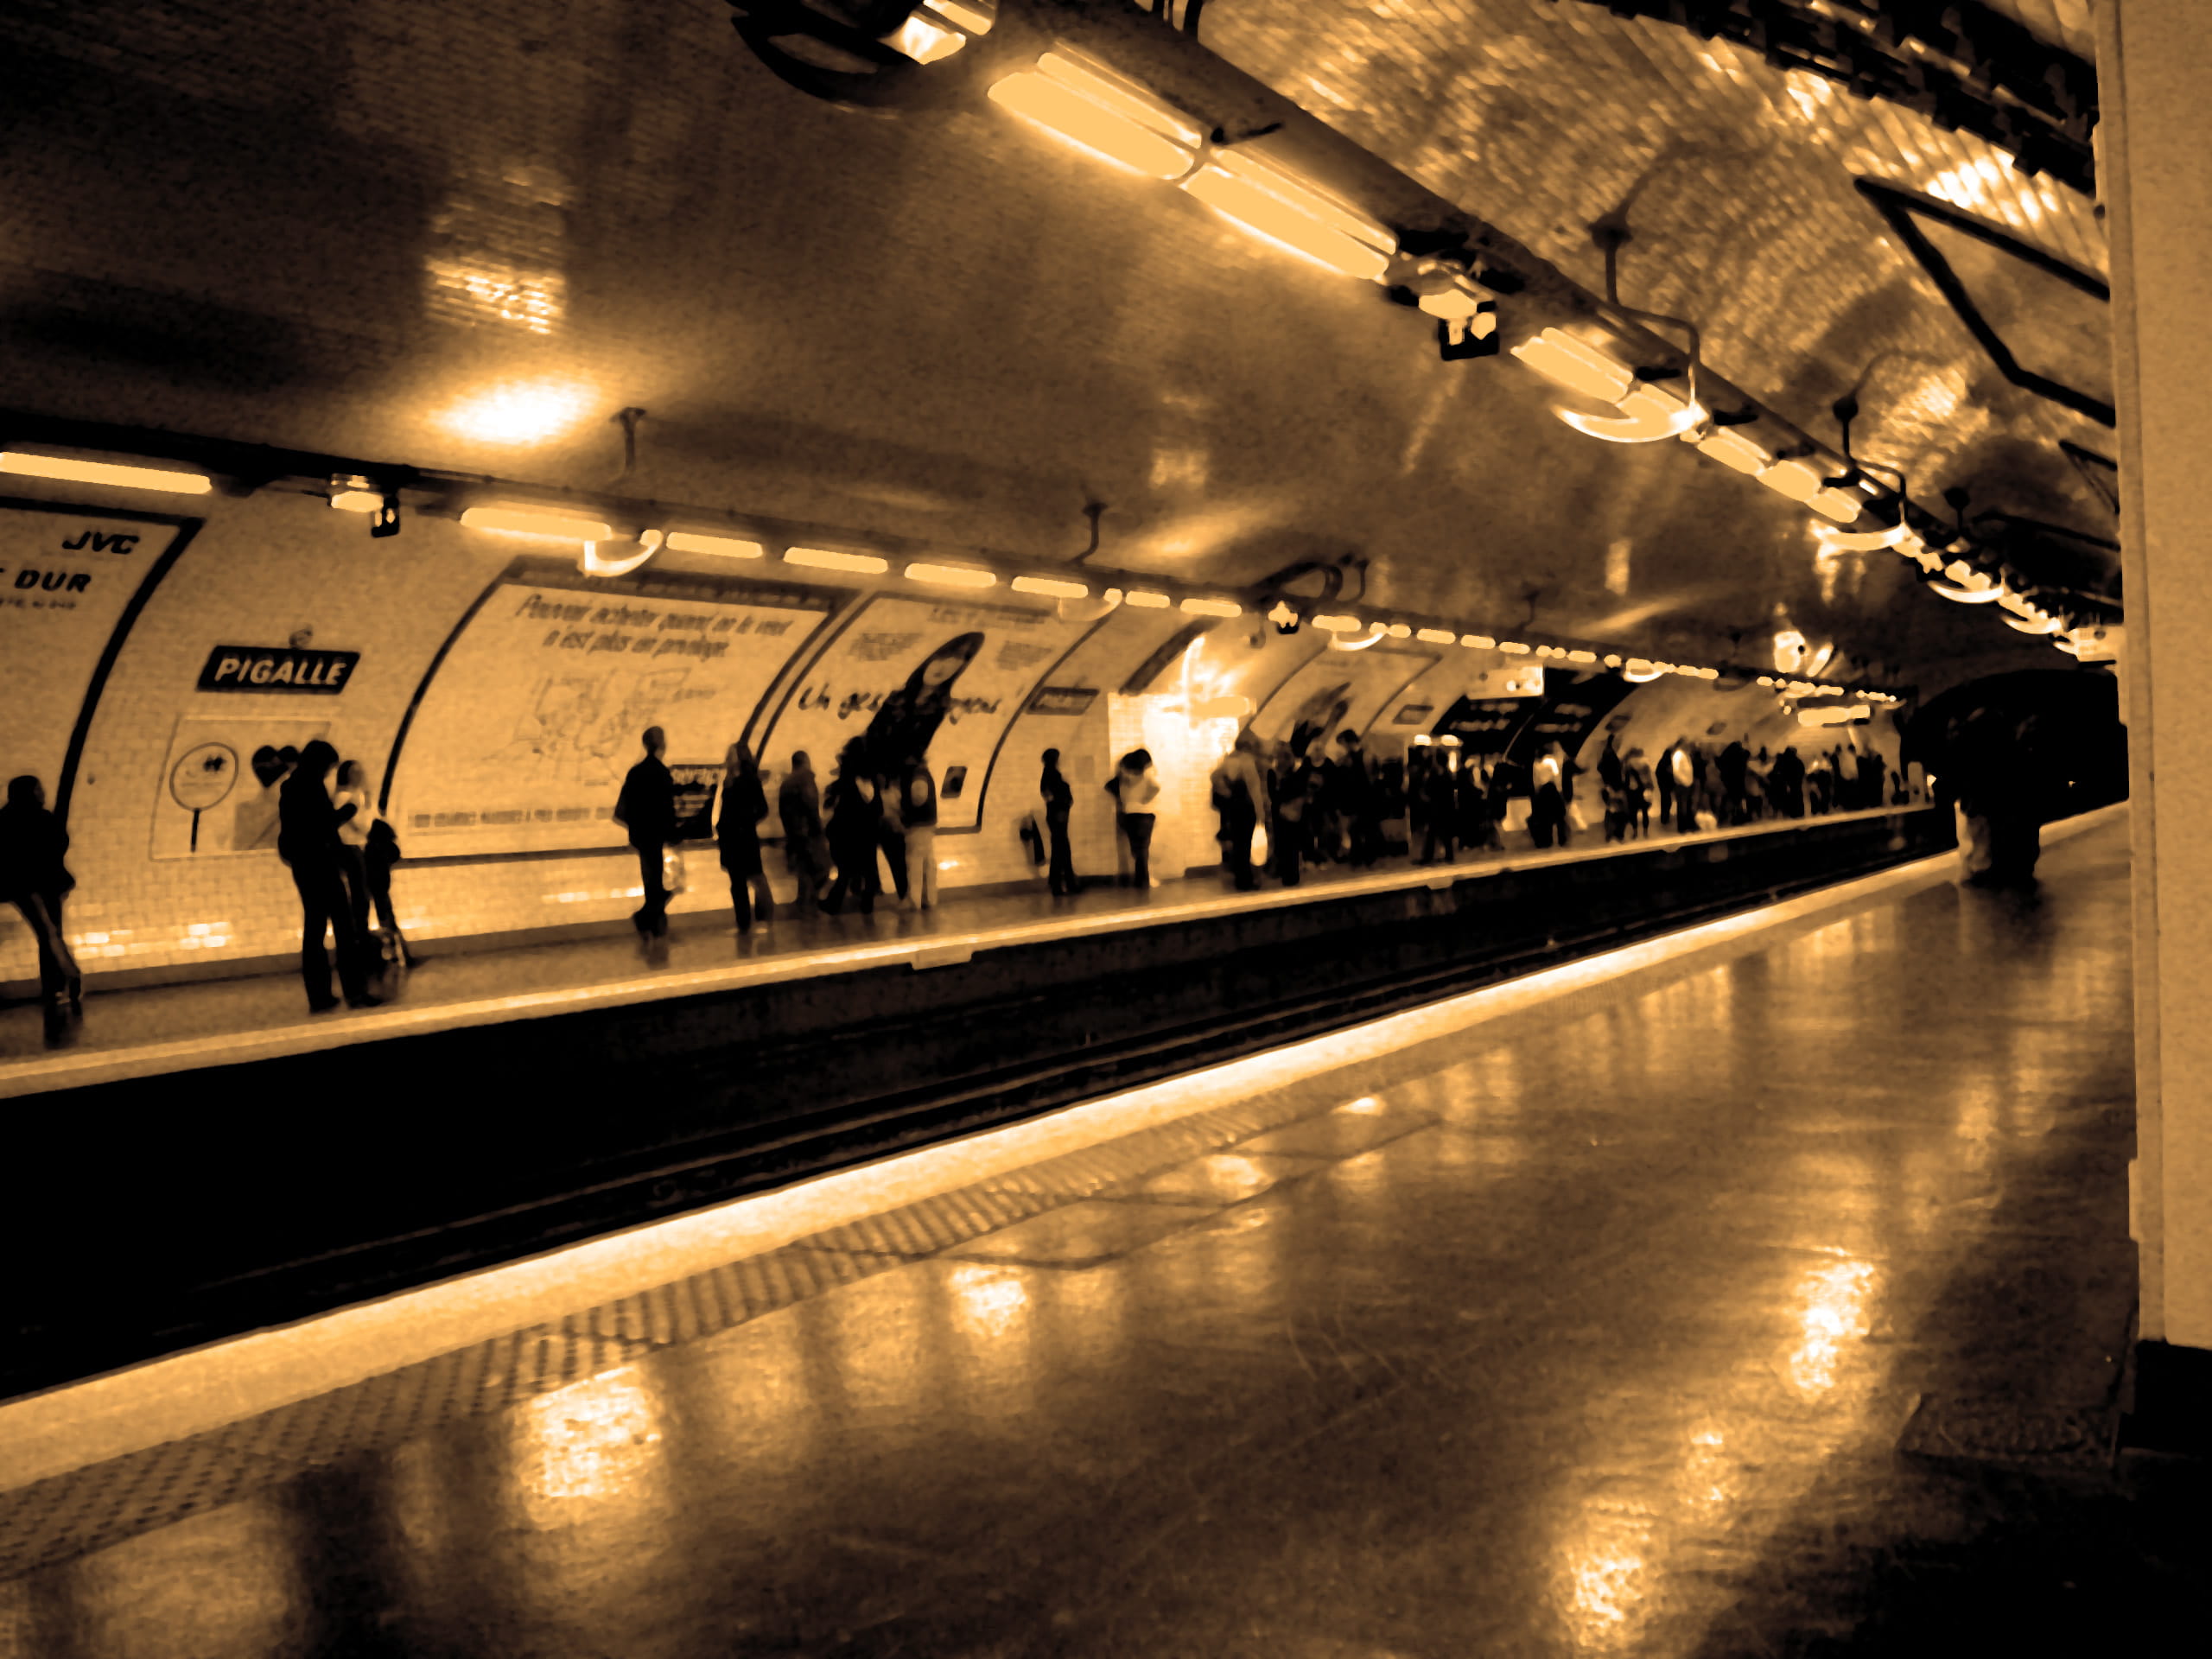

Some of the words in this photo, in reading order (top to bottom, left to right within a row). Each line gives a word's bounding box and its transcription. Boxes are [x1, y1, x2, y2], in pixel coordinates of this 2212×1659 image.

[62, 531, 141, 555] JVC
[15, 569, 92, 593] DUR
[213, 656, 347, 685] PIGALLE
